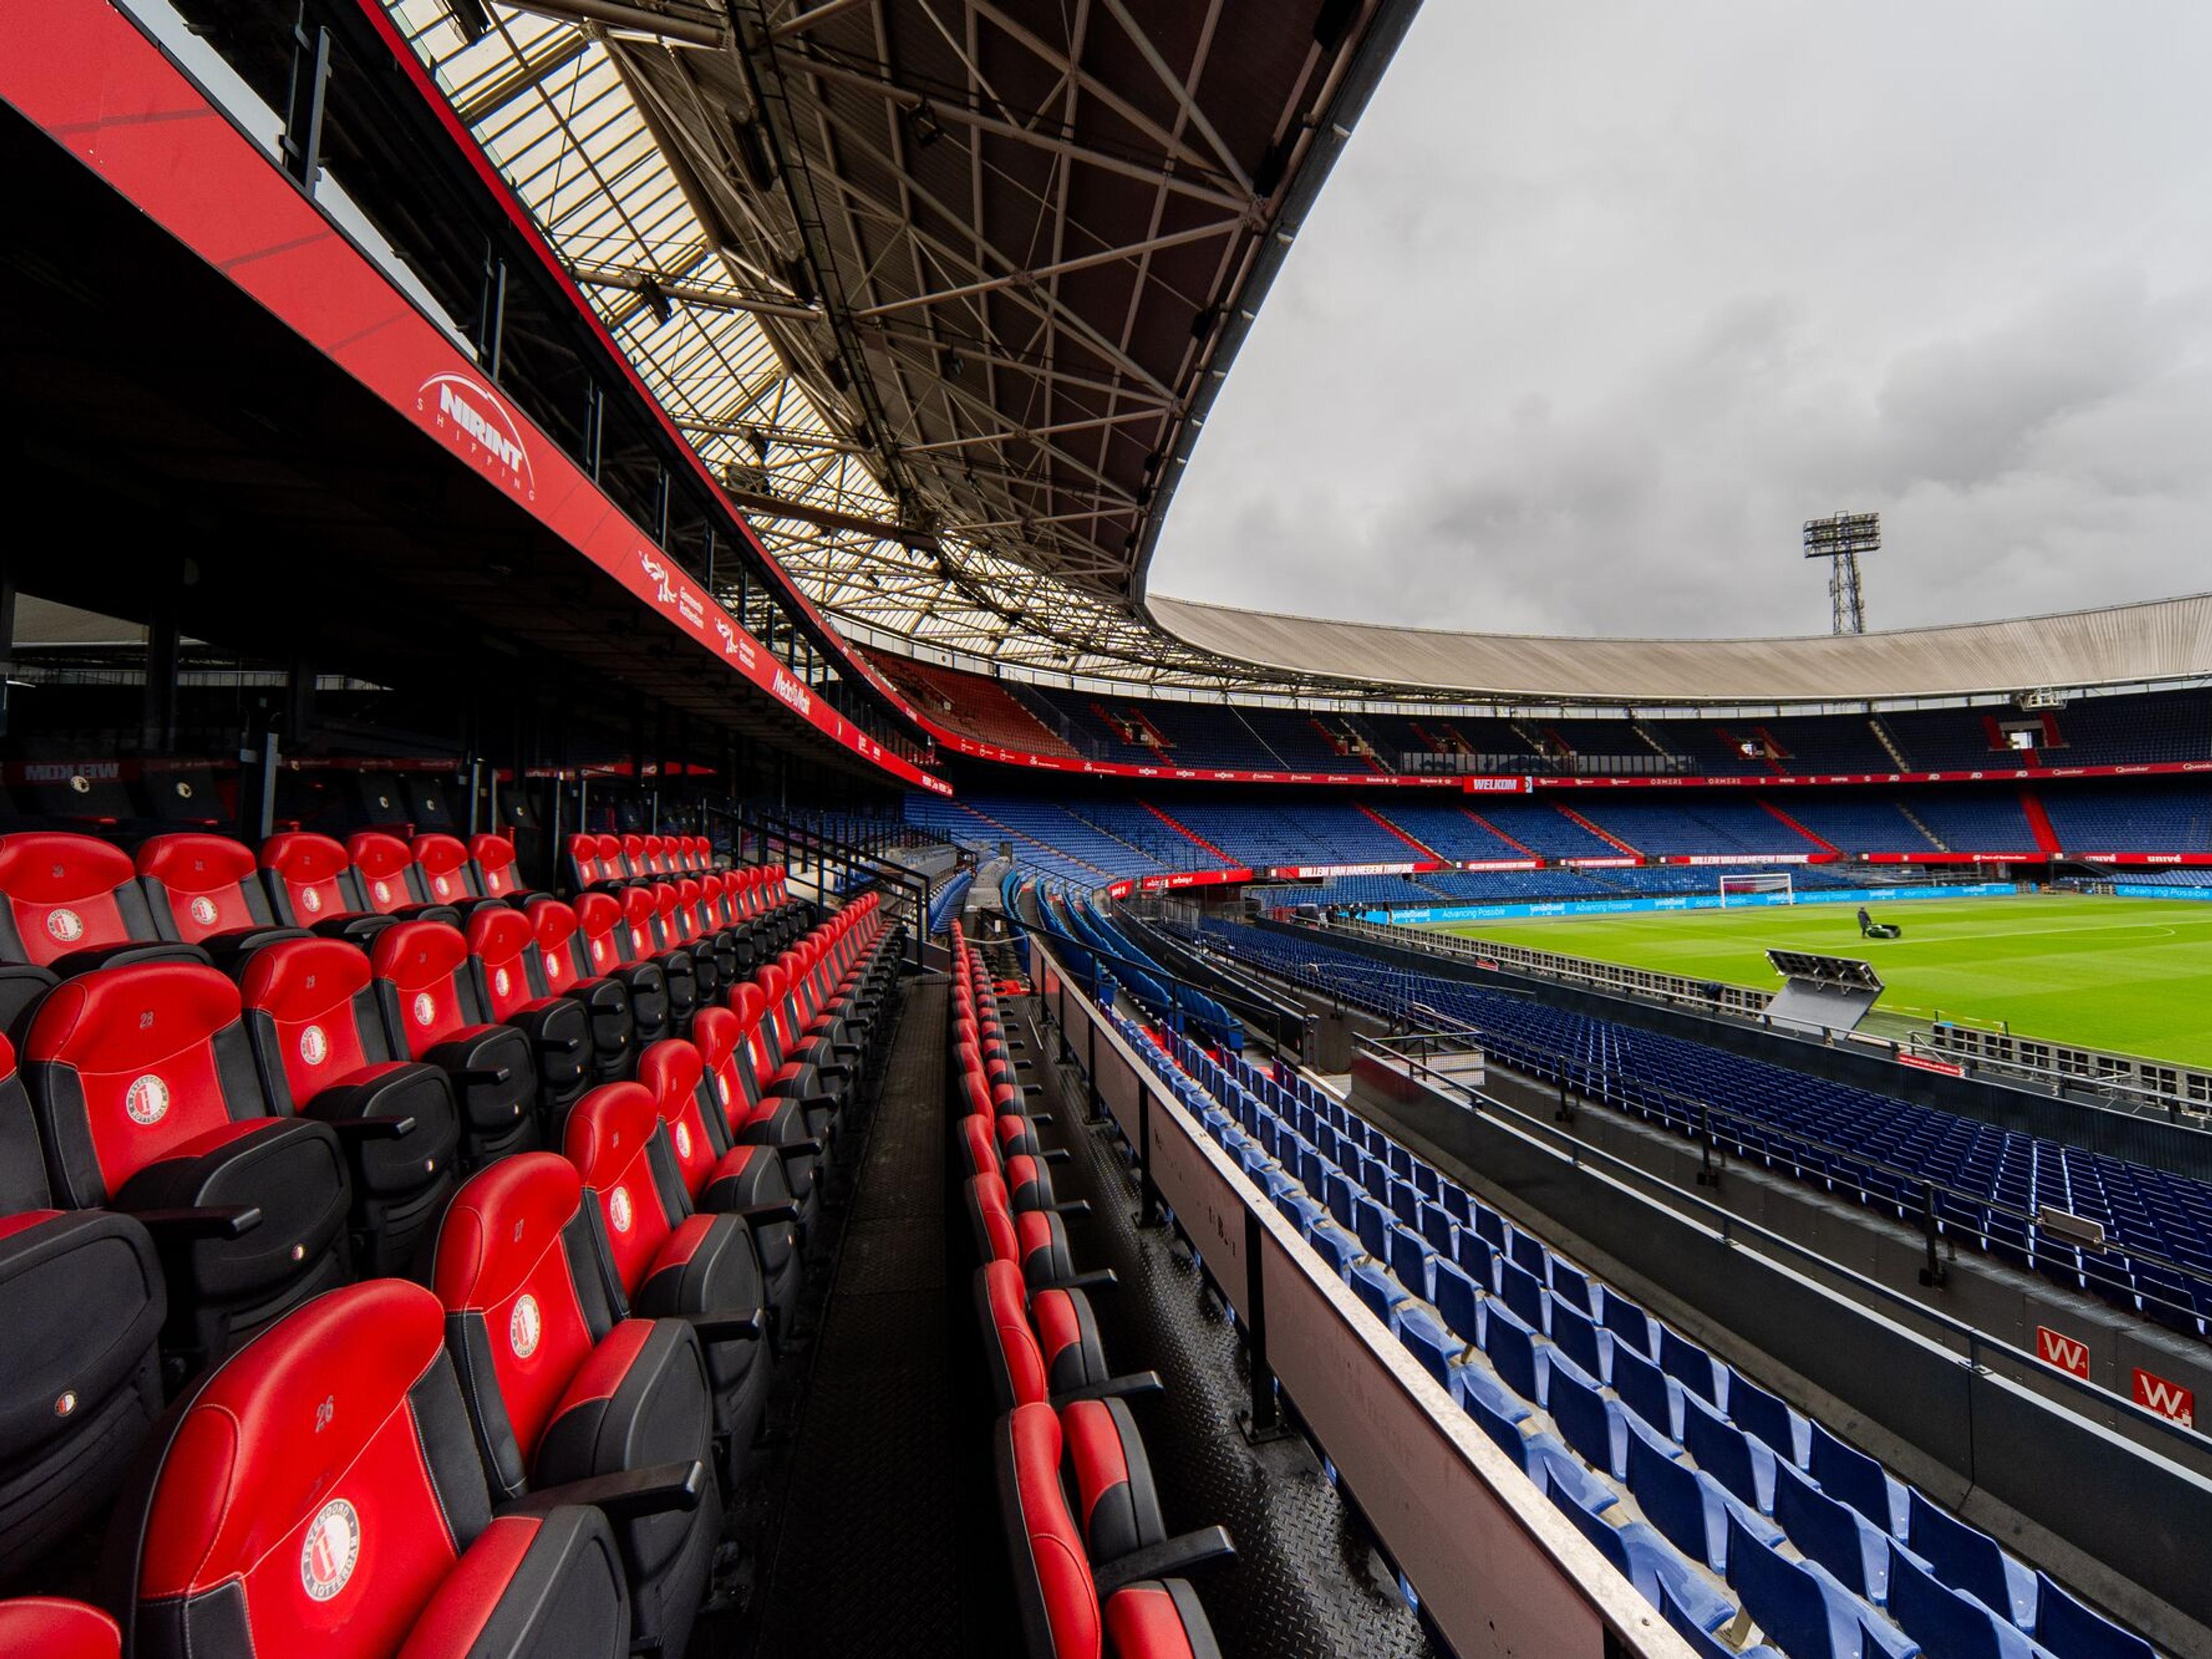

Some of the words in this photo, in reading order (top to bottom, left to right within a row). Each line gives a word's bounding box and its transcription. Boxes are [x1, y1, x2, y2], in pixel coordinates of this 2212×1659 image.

[440, 383, 523, 472] NIRINT
[417, 397, 535, 501] SHIPPING
[1473, 779, 1517, 790] WELKOM
[2147, 854, 2181, 862] univé
[1443, 910, 1477, 919] Advancing
[316, 1395, 334, 1434] 26
